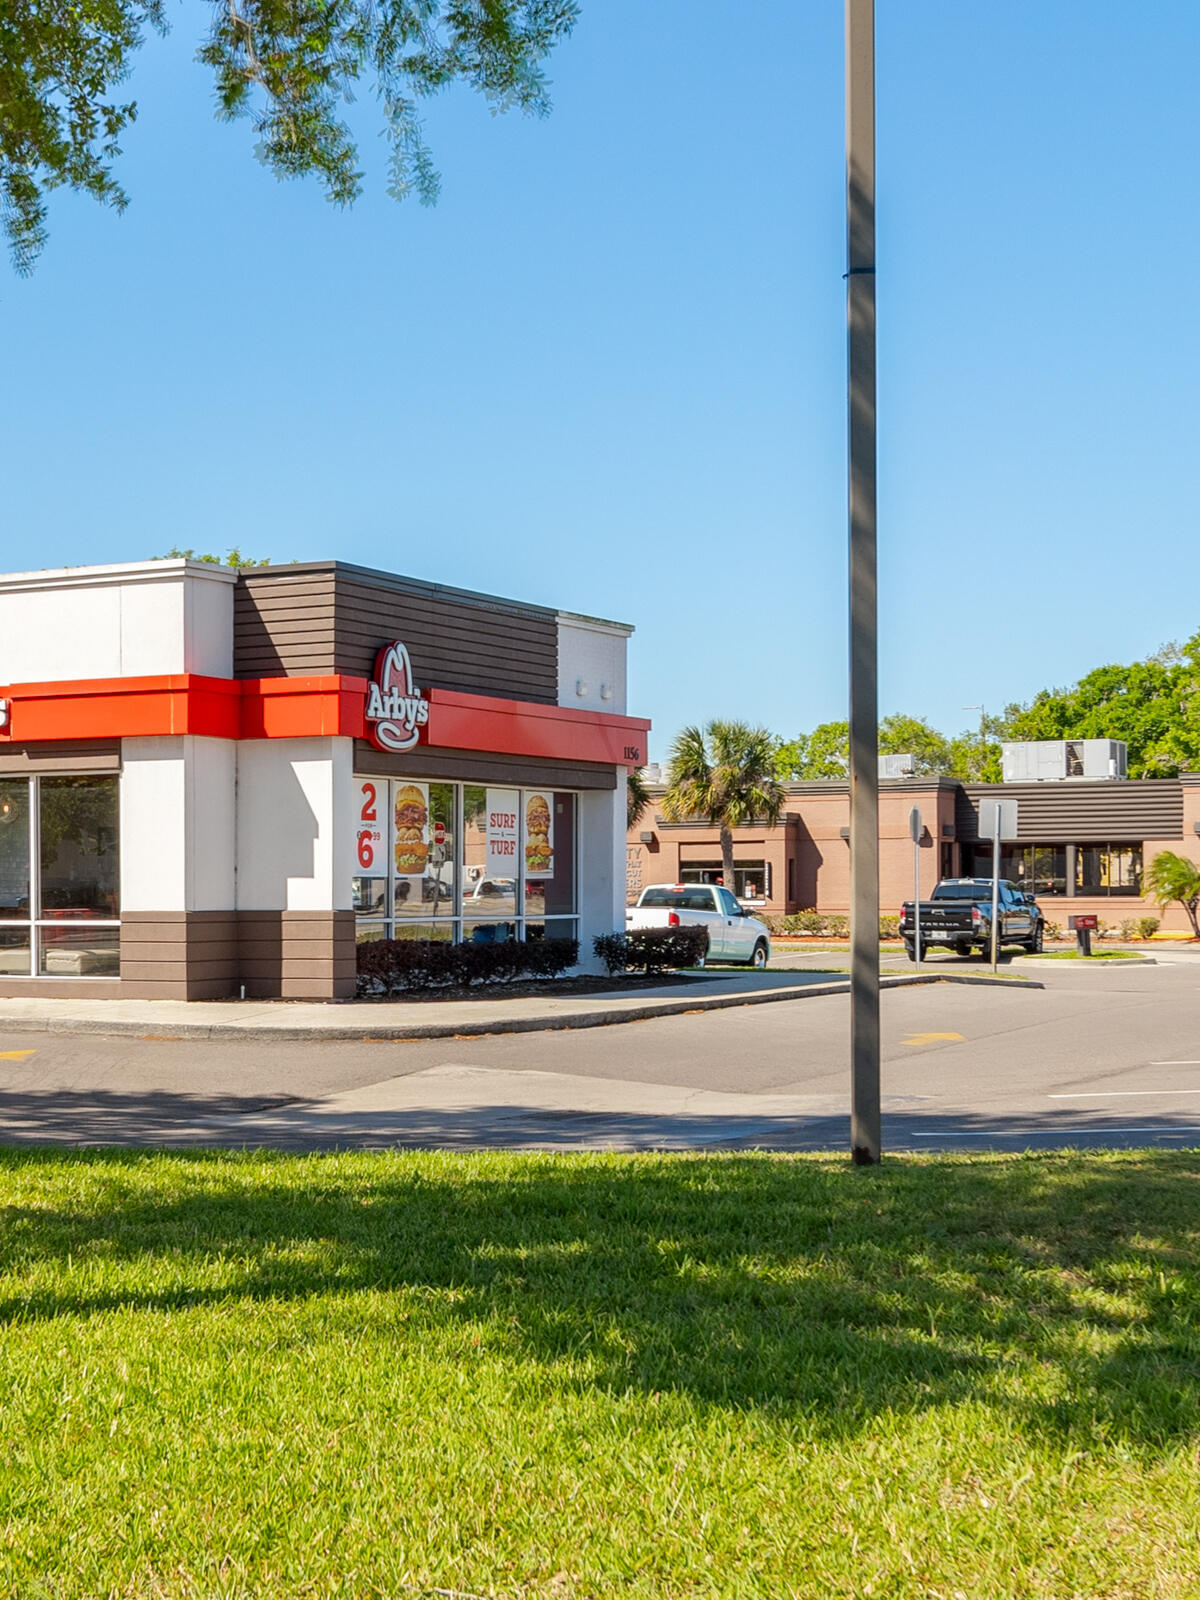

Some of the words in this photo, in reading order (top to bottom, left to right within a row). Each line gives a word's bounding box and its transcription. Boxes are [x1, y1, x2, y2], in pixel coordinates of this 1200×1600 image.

[368, 683, 428, 731] Arby's
[623, 746, 640, 760] 1156
[361, 783, 377, 821] 2
[490, 812, 516, 828] SURF
[490, 839, 516, 855] TURF
